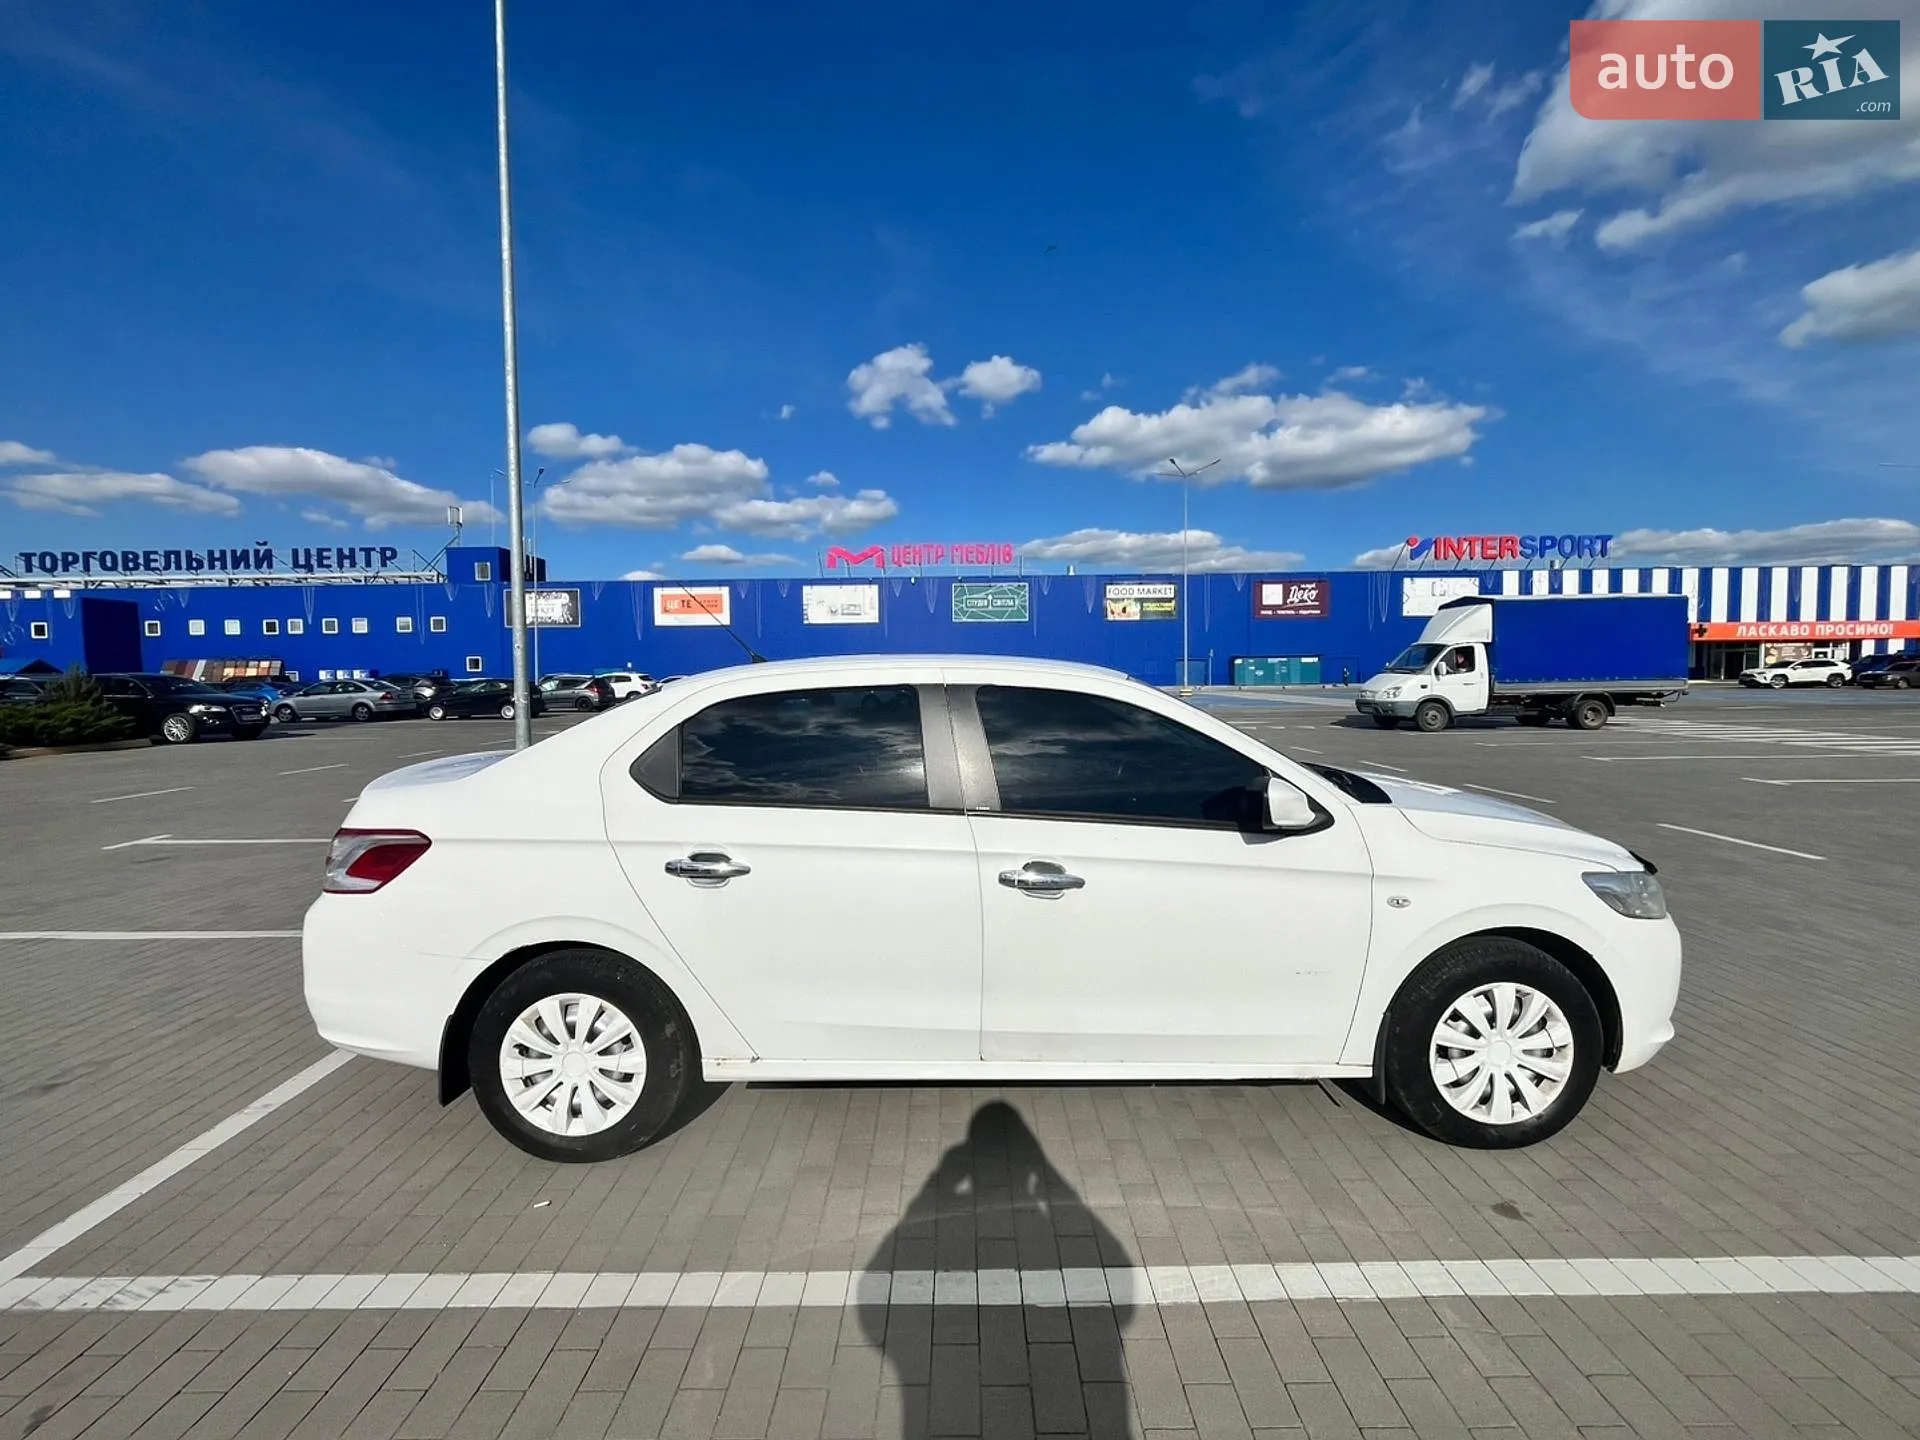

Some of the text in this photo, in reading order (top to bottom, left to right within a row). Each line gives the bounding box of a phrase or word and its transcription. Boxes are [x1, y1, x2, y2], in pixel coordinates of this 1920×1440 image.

[18, 541, 398, 574] ТОРГОВЕЛЬНИЙ ЦЕНТР
[891, 543, 946, 567] ЦЕНТР
[949, 543, 1014, 566] МЕБЛІВ
[1434, 534, 1615, 560] INTERSPORT
[1108, 587, 1173, 596] FOOD MARKET
[1736, 623, 1894, 637] ЛАСКАВО ПРОСИМО!
